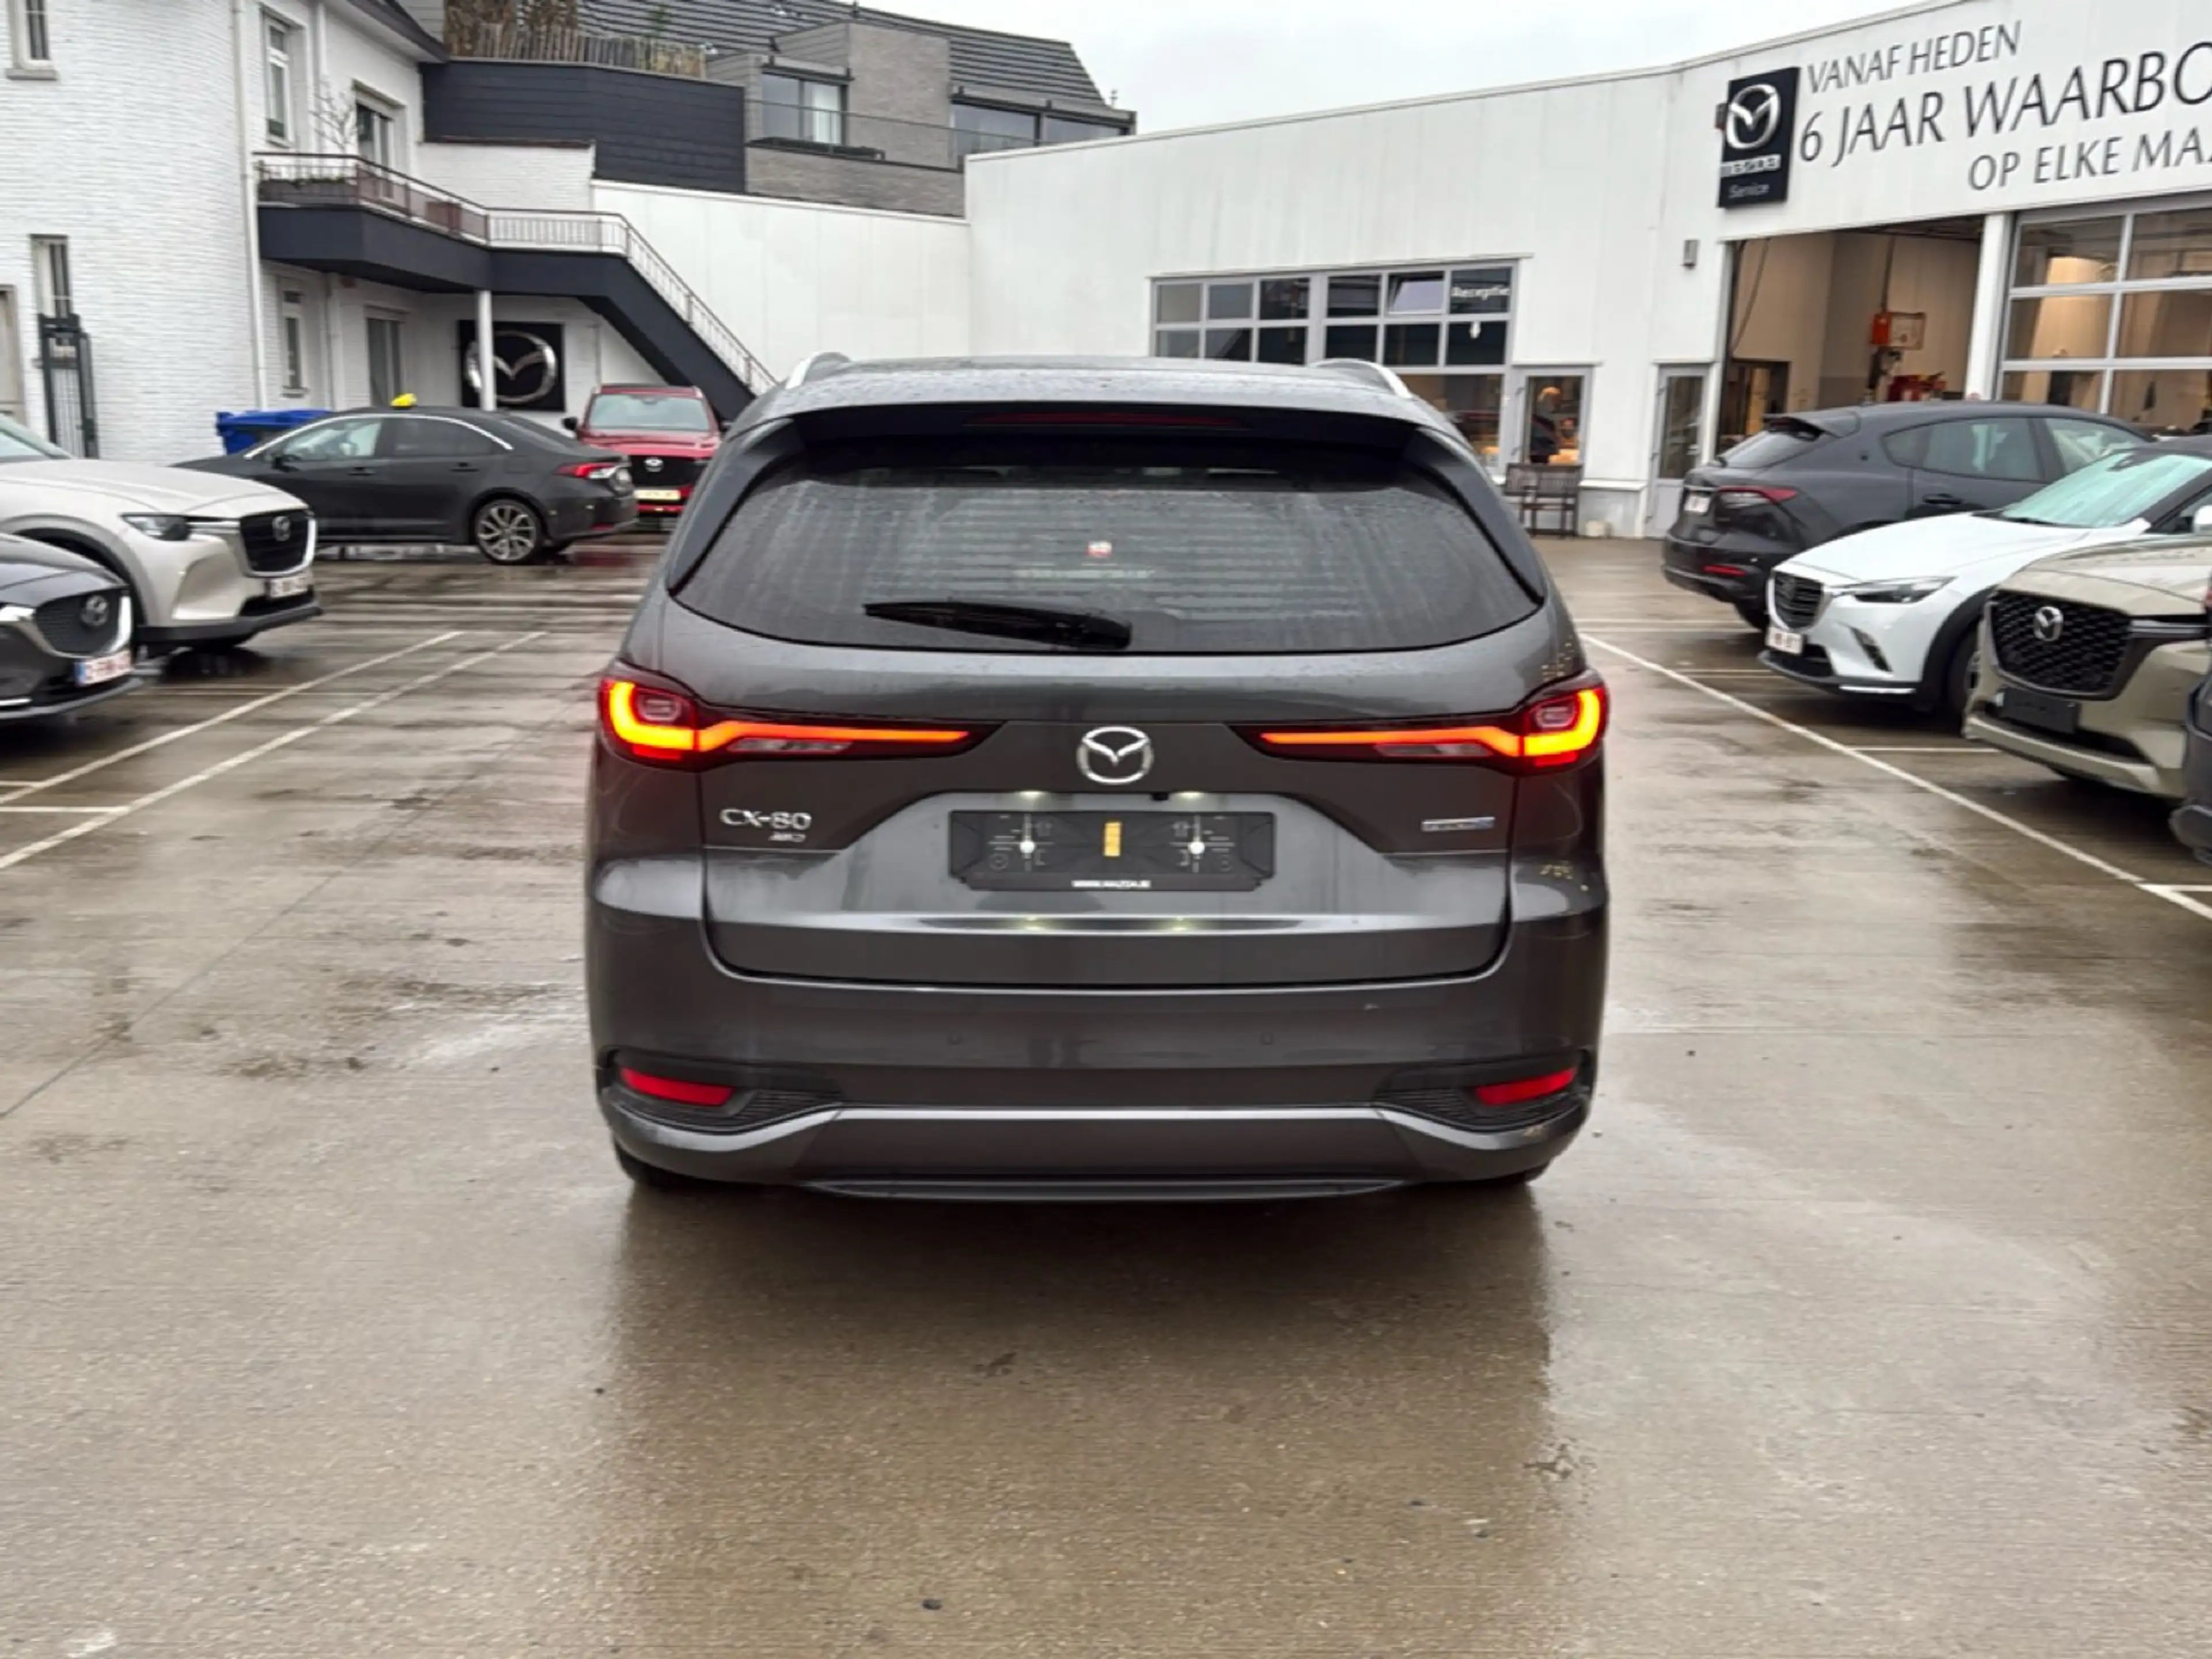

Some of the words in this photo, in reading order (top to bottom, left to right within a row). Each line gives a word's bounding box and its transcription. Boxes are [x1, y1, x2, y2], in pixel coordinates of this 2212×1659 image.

[1807, 44, 1903, 94] VANAF
[1907, 20, 2022, 75] HEDEN
[1800, 111, 1823, 163] 6
[1831, 91, 1946, 168] JAAR
[1963, 41, 2212, 138] WAARBO
[1968, 151, 2021, 192] OP
[2034, 136, 2123, 184] ELKE
[2131, 126, 2212, 173] MA
[719, 808, 812, 830] CX-80
